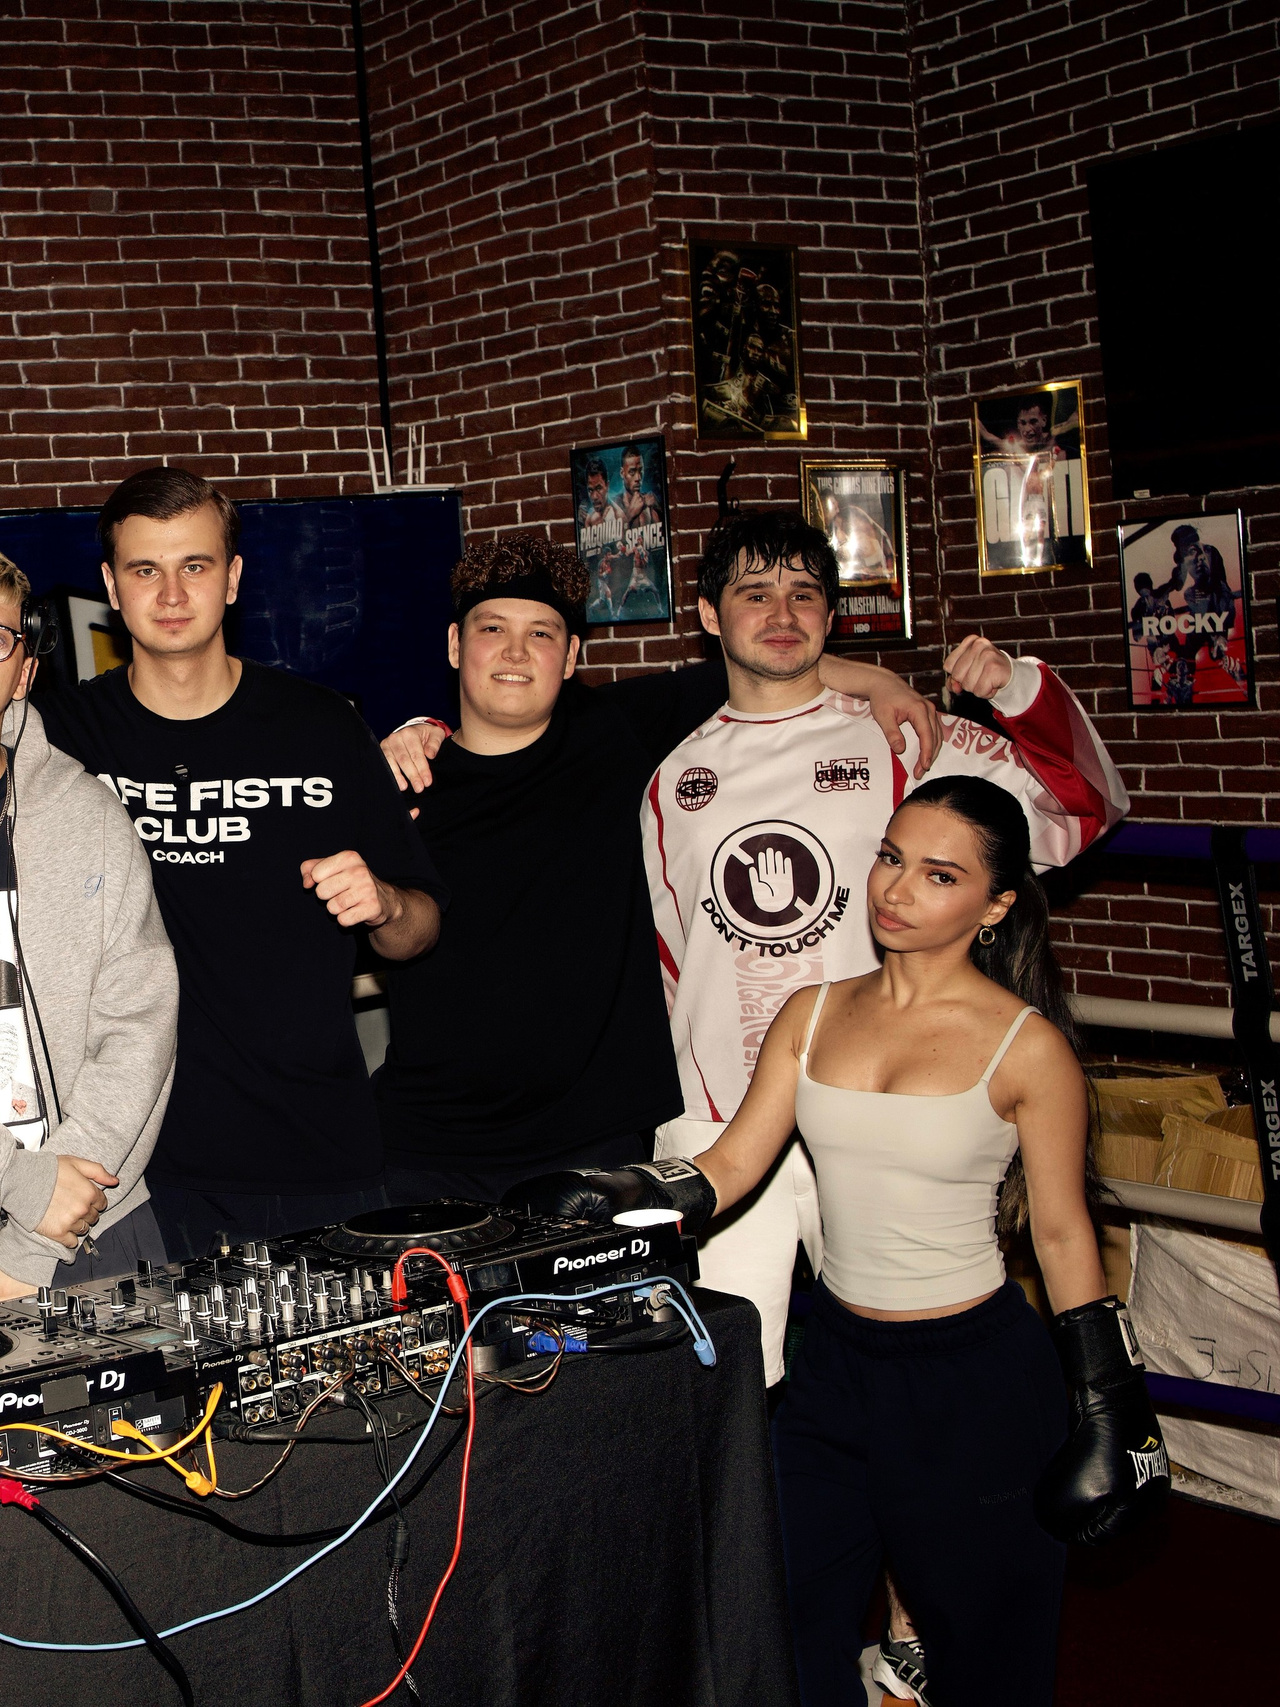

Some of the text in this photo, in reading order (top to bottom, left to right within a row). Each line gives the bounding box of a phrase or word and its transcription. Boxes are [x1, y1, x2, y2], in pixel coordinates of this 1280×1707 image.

[580, 518, 623, 551] PACQUIAO
[848, 595, 876, 616] NASEEM
[853, 623, 870, 633] HBO
[1141, 611, 1229, 637] ROCKY
[816, 765, 870, 783] culture
[96, 773, 334, 812] AFE FISTS
[133, 816, 251, 844] CLUB
[152, 849, 225, 864] COACH
[700, 885, 851, 958] DON'T TOUCH ME
[1228, 882, 1259, 983] TARGEX
[553, 1247, 626, 1275] Pioneer
[202, 1357, 234, 1370] Pioneer
[1129, 1440, 1169, 1490] EVERLAST
